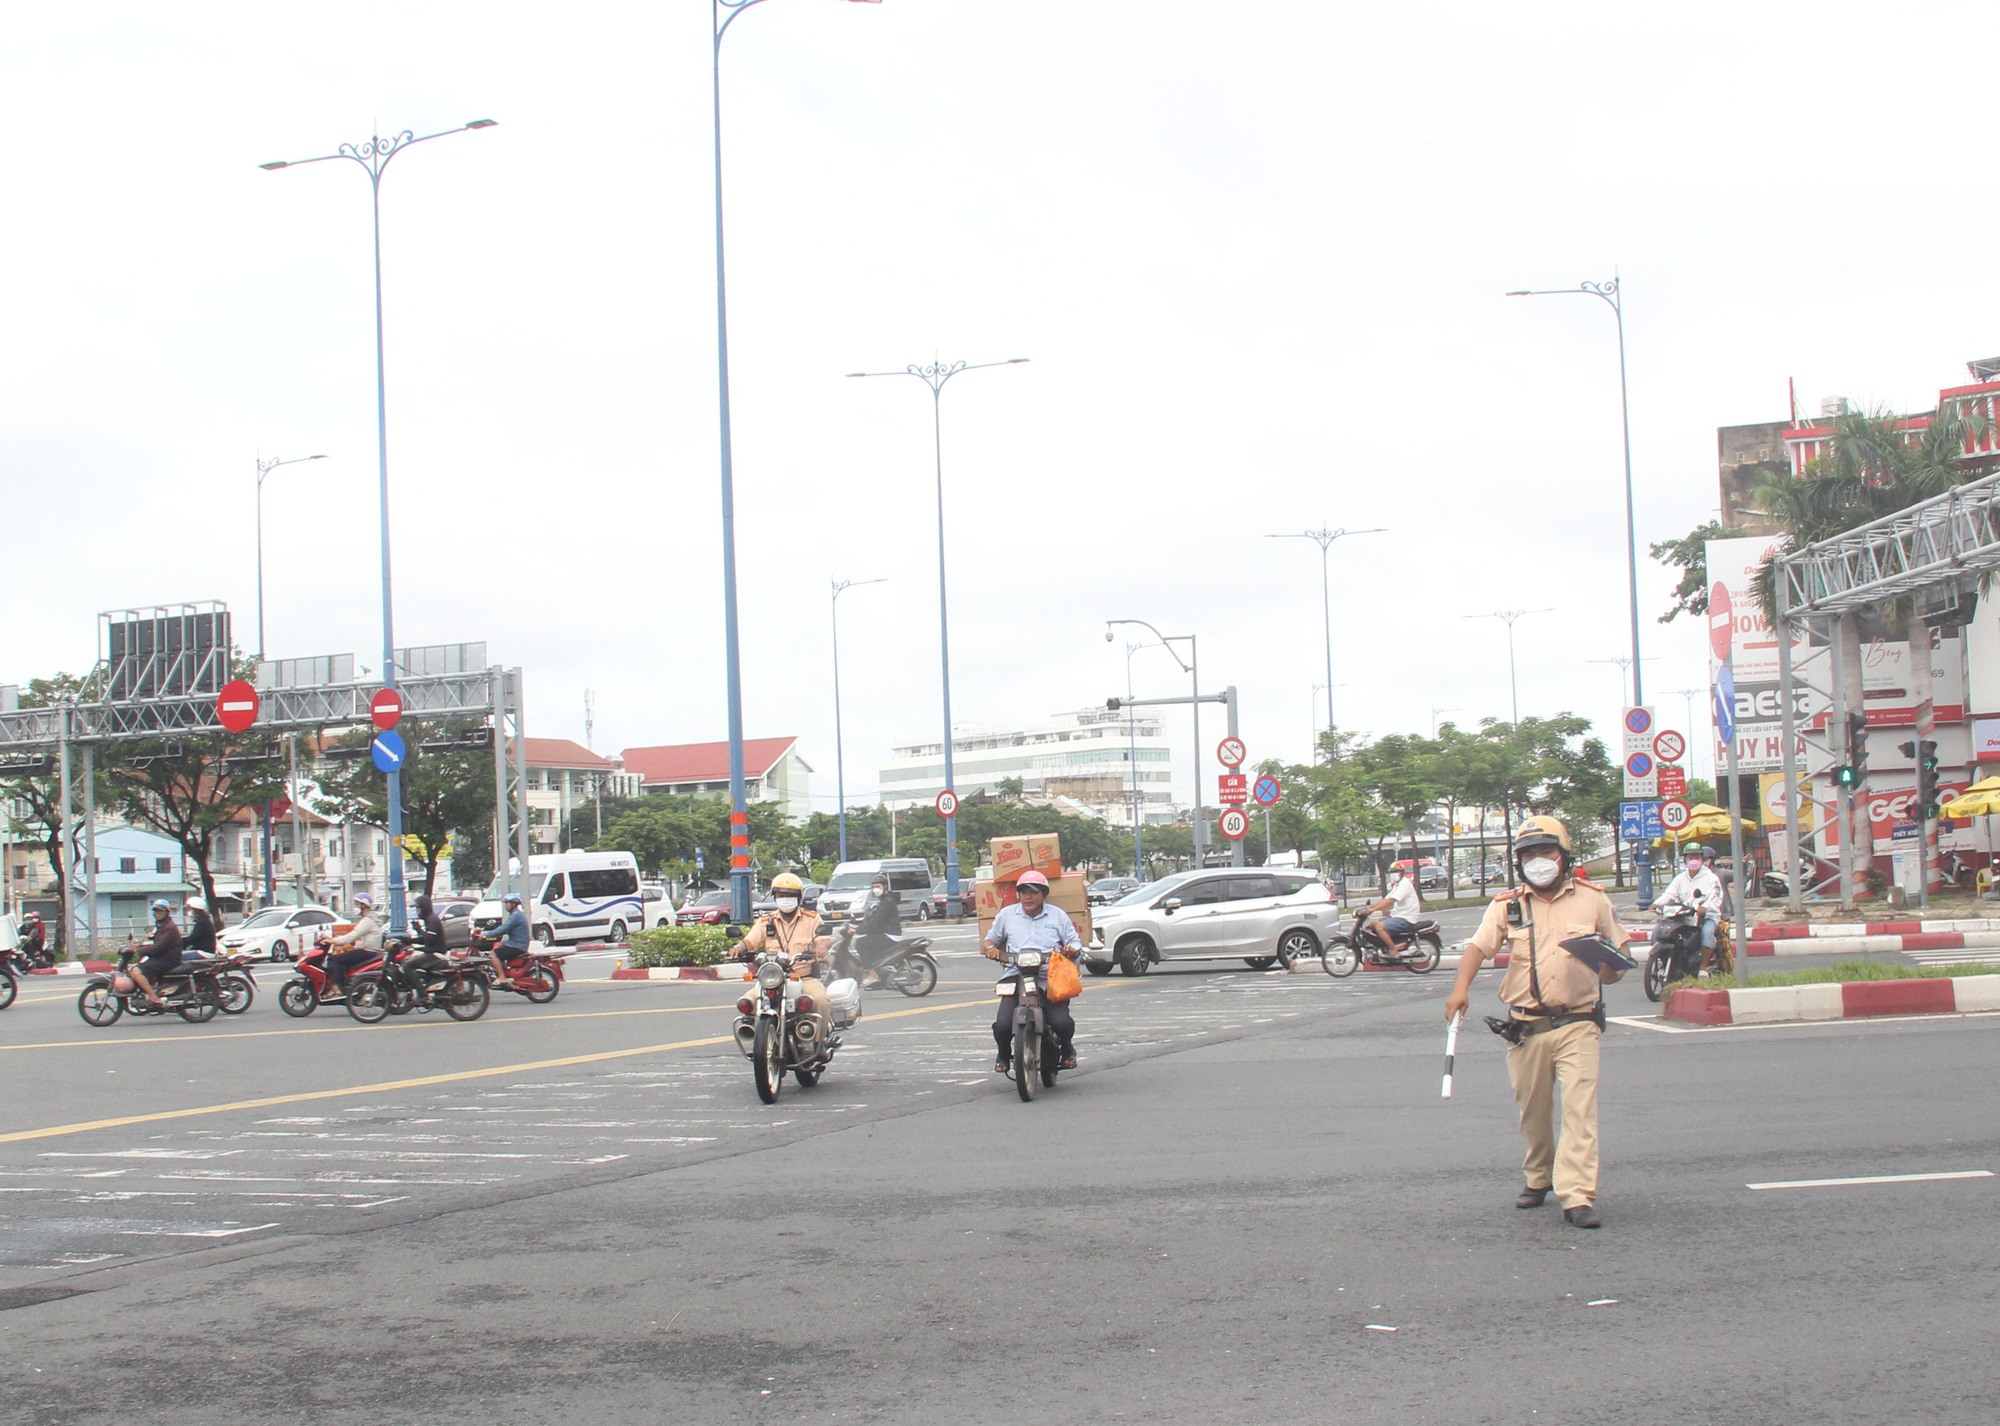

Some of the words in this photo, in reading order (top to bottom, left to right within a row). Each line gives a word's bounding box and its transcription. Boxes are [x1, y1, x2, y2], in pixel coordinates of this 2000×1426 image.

[942, 797, 952, 810] 60
[1667, 807, 1682, 822] 50
[1227, 817, 1240, 831] 60
